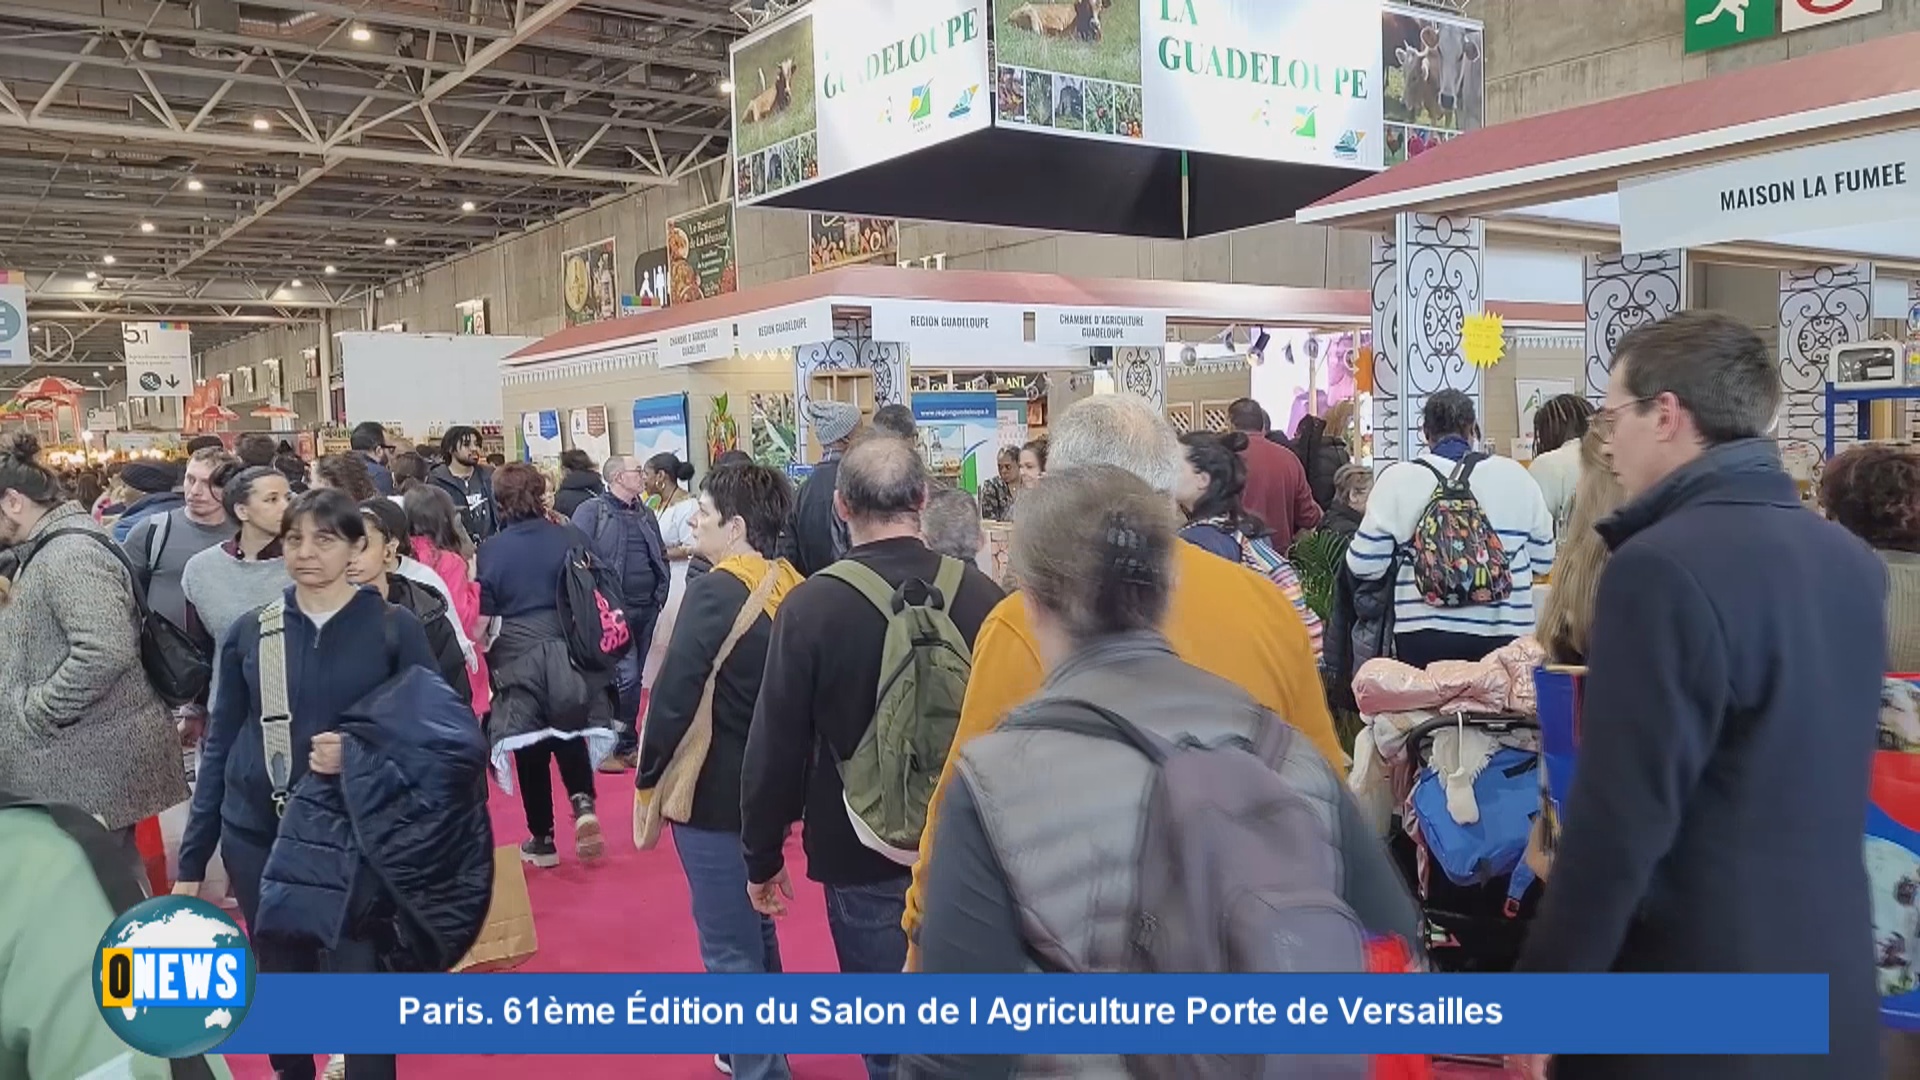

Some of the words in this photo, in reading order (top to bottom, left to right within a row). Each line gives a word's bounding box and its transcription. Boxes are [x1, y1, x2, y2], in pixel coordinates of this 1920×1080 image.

[1160, 0, 1198, 25] LA
[823, 7, 979, 99] GUDELOUPE
[1720, 179, 1795, 211] MAISON
[1802, 175, 1828, 199] LA
[1834, 161, 1907, 194] FUMEE
[758, 325, 775, 337] REGION
[775, 317, 807, 333] GUADELOUPE
[910, 315, 939, 328] REGION
[941, 316, 990, 329] GUADELOUPE
[1059, 313, 1093, 325] CHAMBRE
[1094, 314, 1144, 327] D'AGRICULTURE
[1081, 327, 1124, 339] GUADELOUPE
